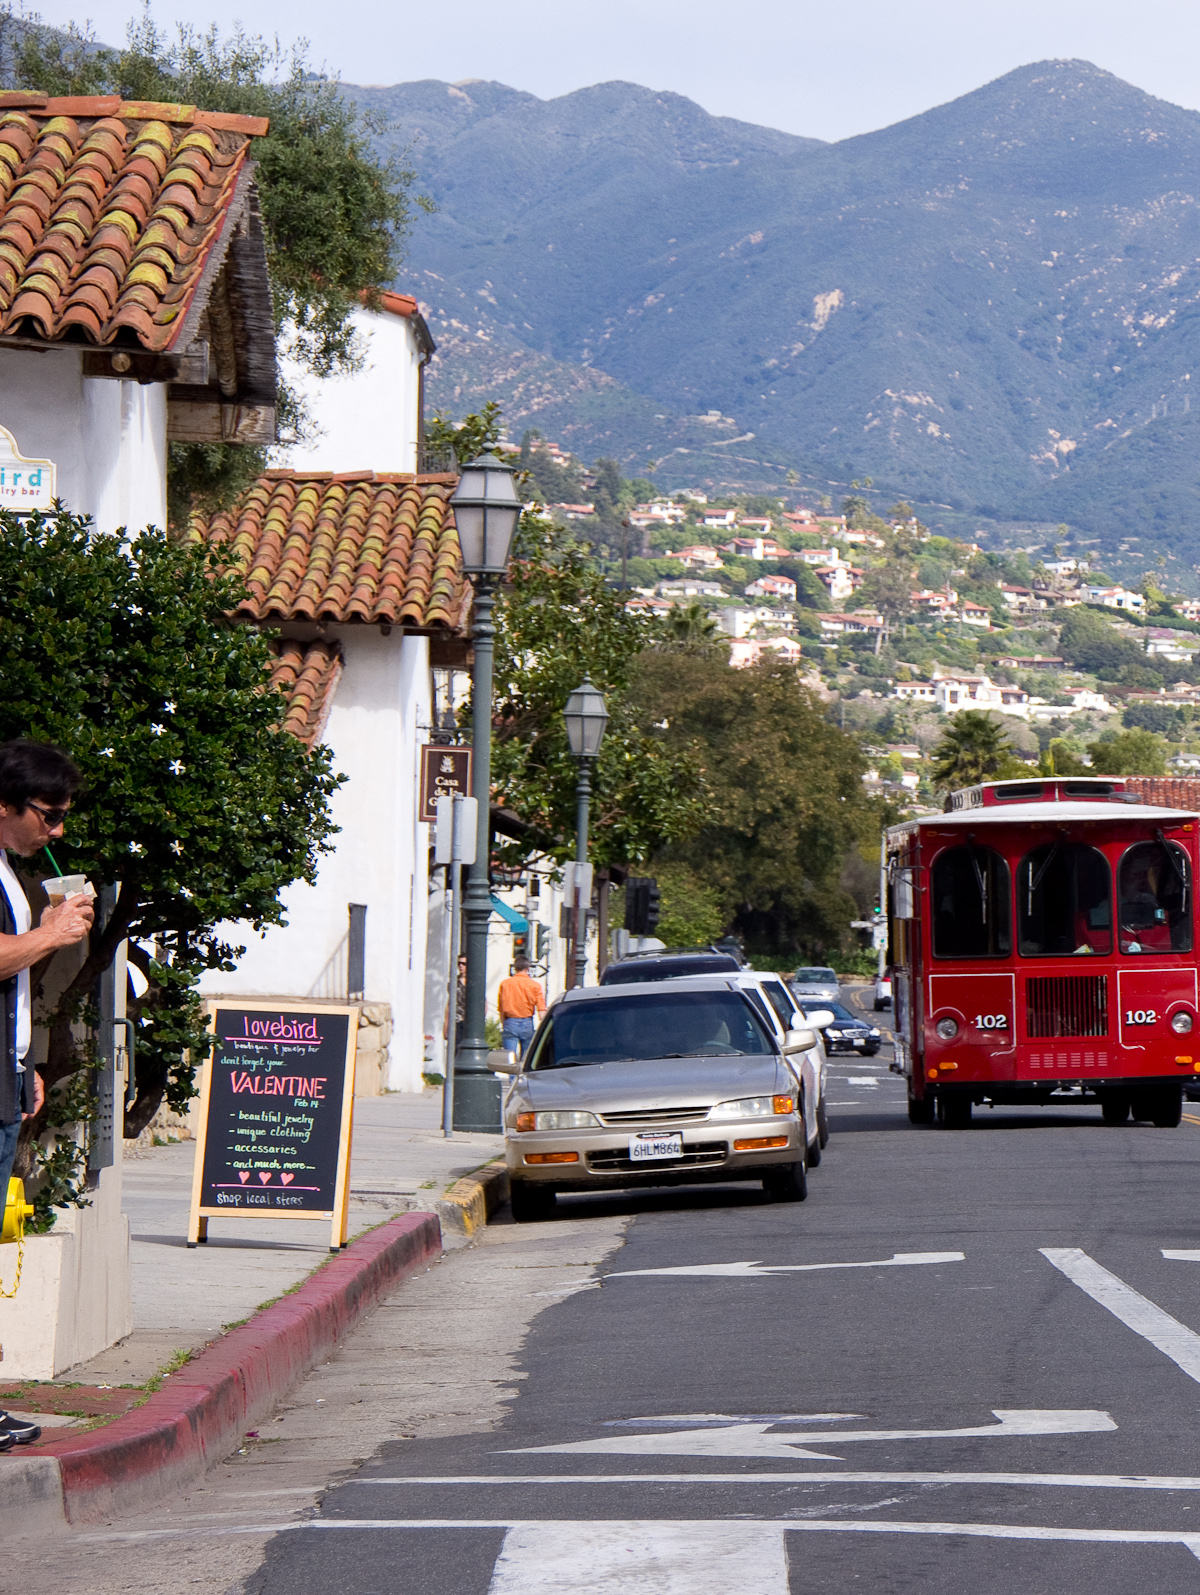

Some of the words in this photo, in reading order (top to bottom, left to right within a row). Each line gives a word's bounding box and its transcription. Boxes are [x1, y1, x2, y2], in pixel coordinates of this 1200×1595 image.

[21, 487, 41, 496] bar
[434, 776, 460, 787] Casa
[433, 787, 448, 797] de
[974, 1014, 1008, 1030] 102
[1125, 1010, 1157, 1026] 102
[241, 1054, 266, 1072] forget
[230, 1070, 328, 1099] VALENTINE
[293, 1098, 308, 1108] Feb
[238, 1110, 281, 1123] beautiful
[281, 1113, 315, 1132] jewelry
[236, 1126, 267, 1143] unique
[269, 1126, 312, 1144] clothing
[633, 1142, 680, 1157] 6HLM864
[253, 1159, 283, 1170] much
